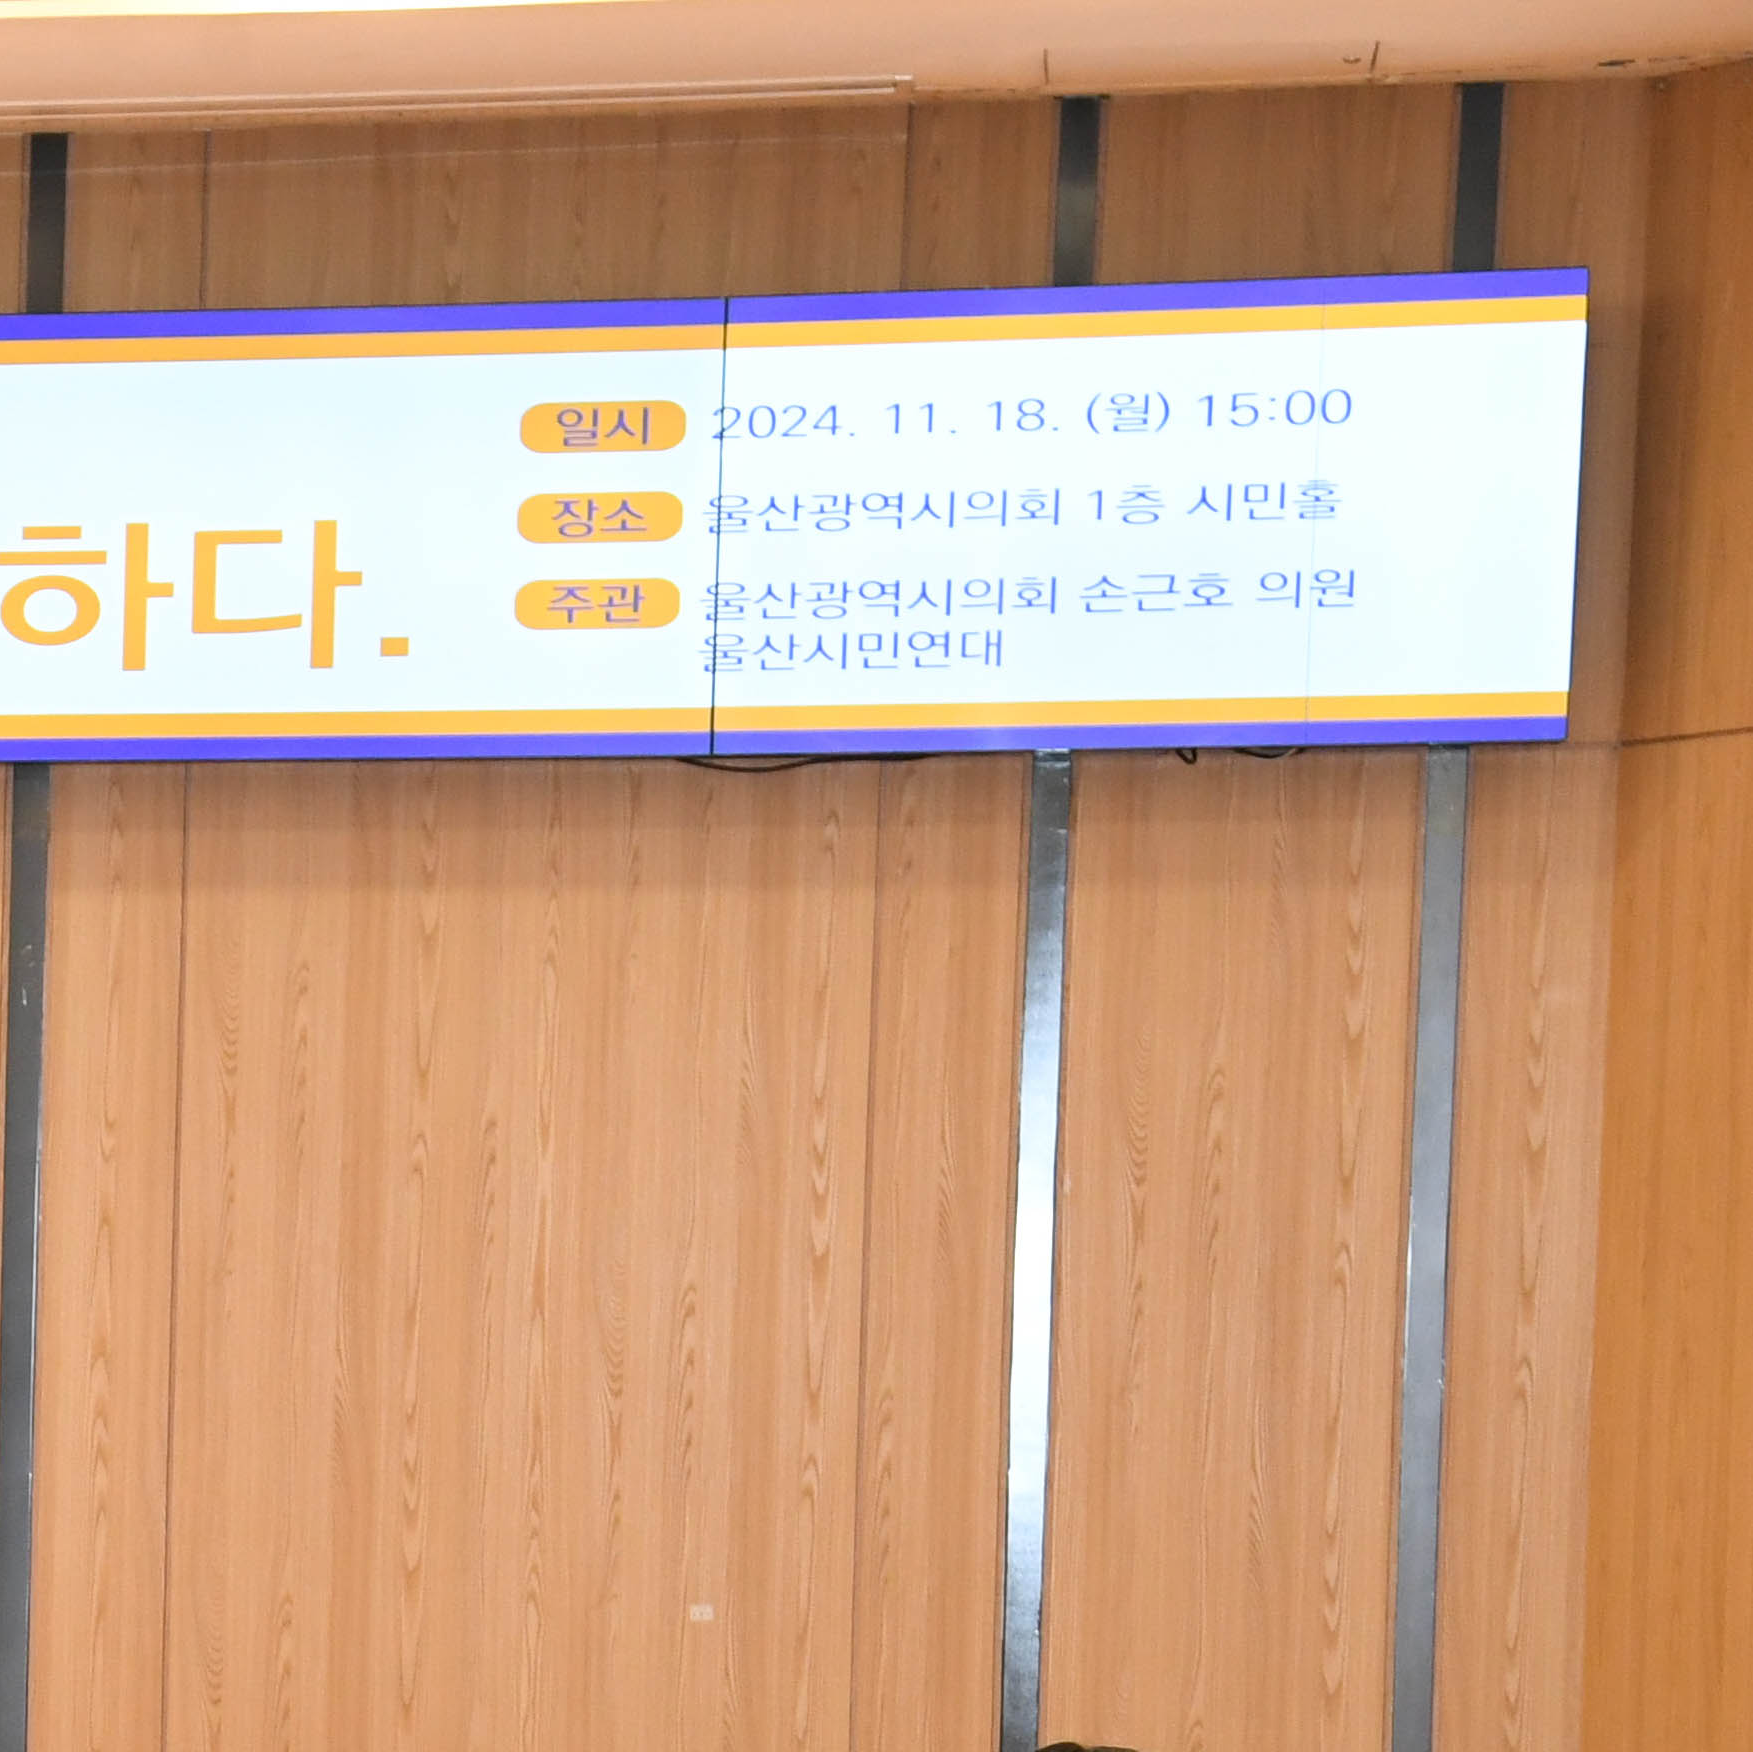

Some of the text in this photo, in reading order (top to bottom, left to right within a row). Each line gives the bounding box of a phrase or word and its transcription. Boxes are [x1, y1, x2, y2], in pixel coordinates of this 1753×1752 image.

[555, 407, 650, 447] 일시
[712, 389, 1352, 440] 2024. 11. 18. (월) 15:00
[552, 498, 647, 537] 장소
[704, 480, 1342, 534] 울산광역시의회 1층 시민홀
[547, 583, 646, 623] 주관
[700, 569, 1355, 622] 울산광역시의회 손근호 의원
[698, 628, 1002, 674] 울산시민연대
